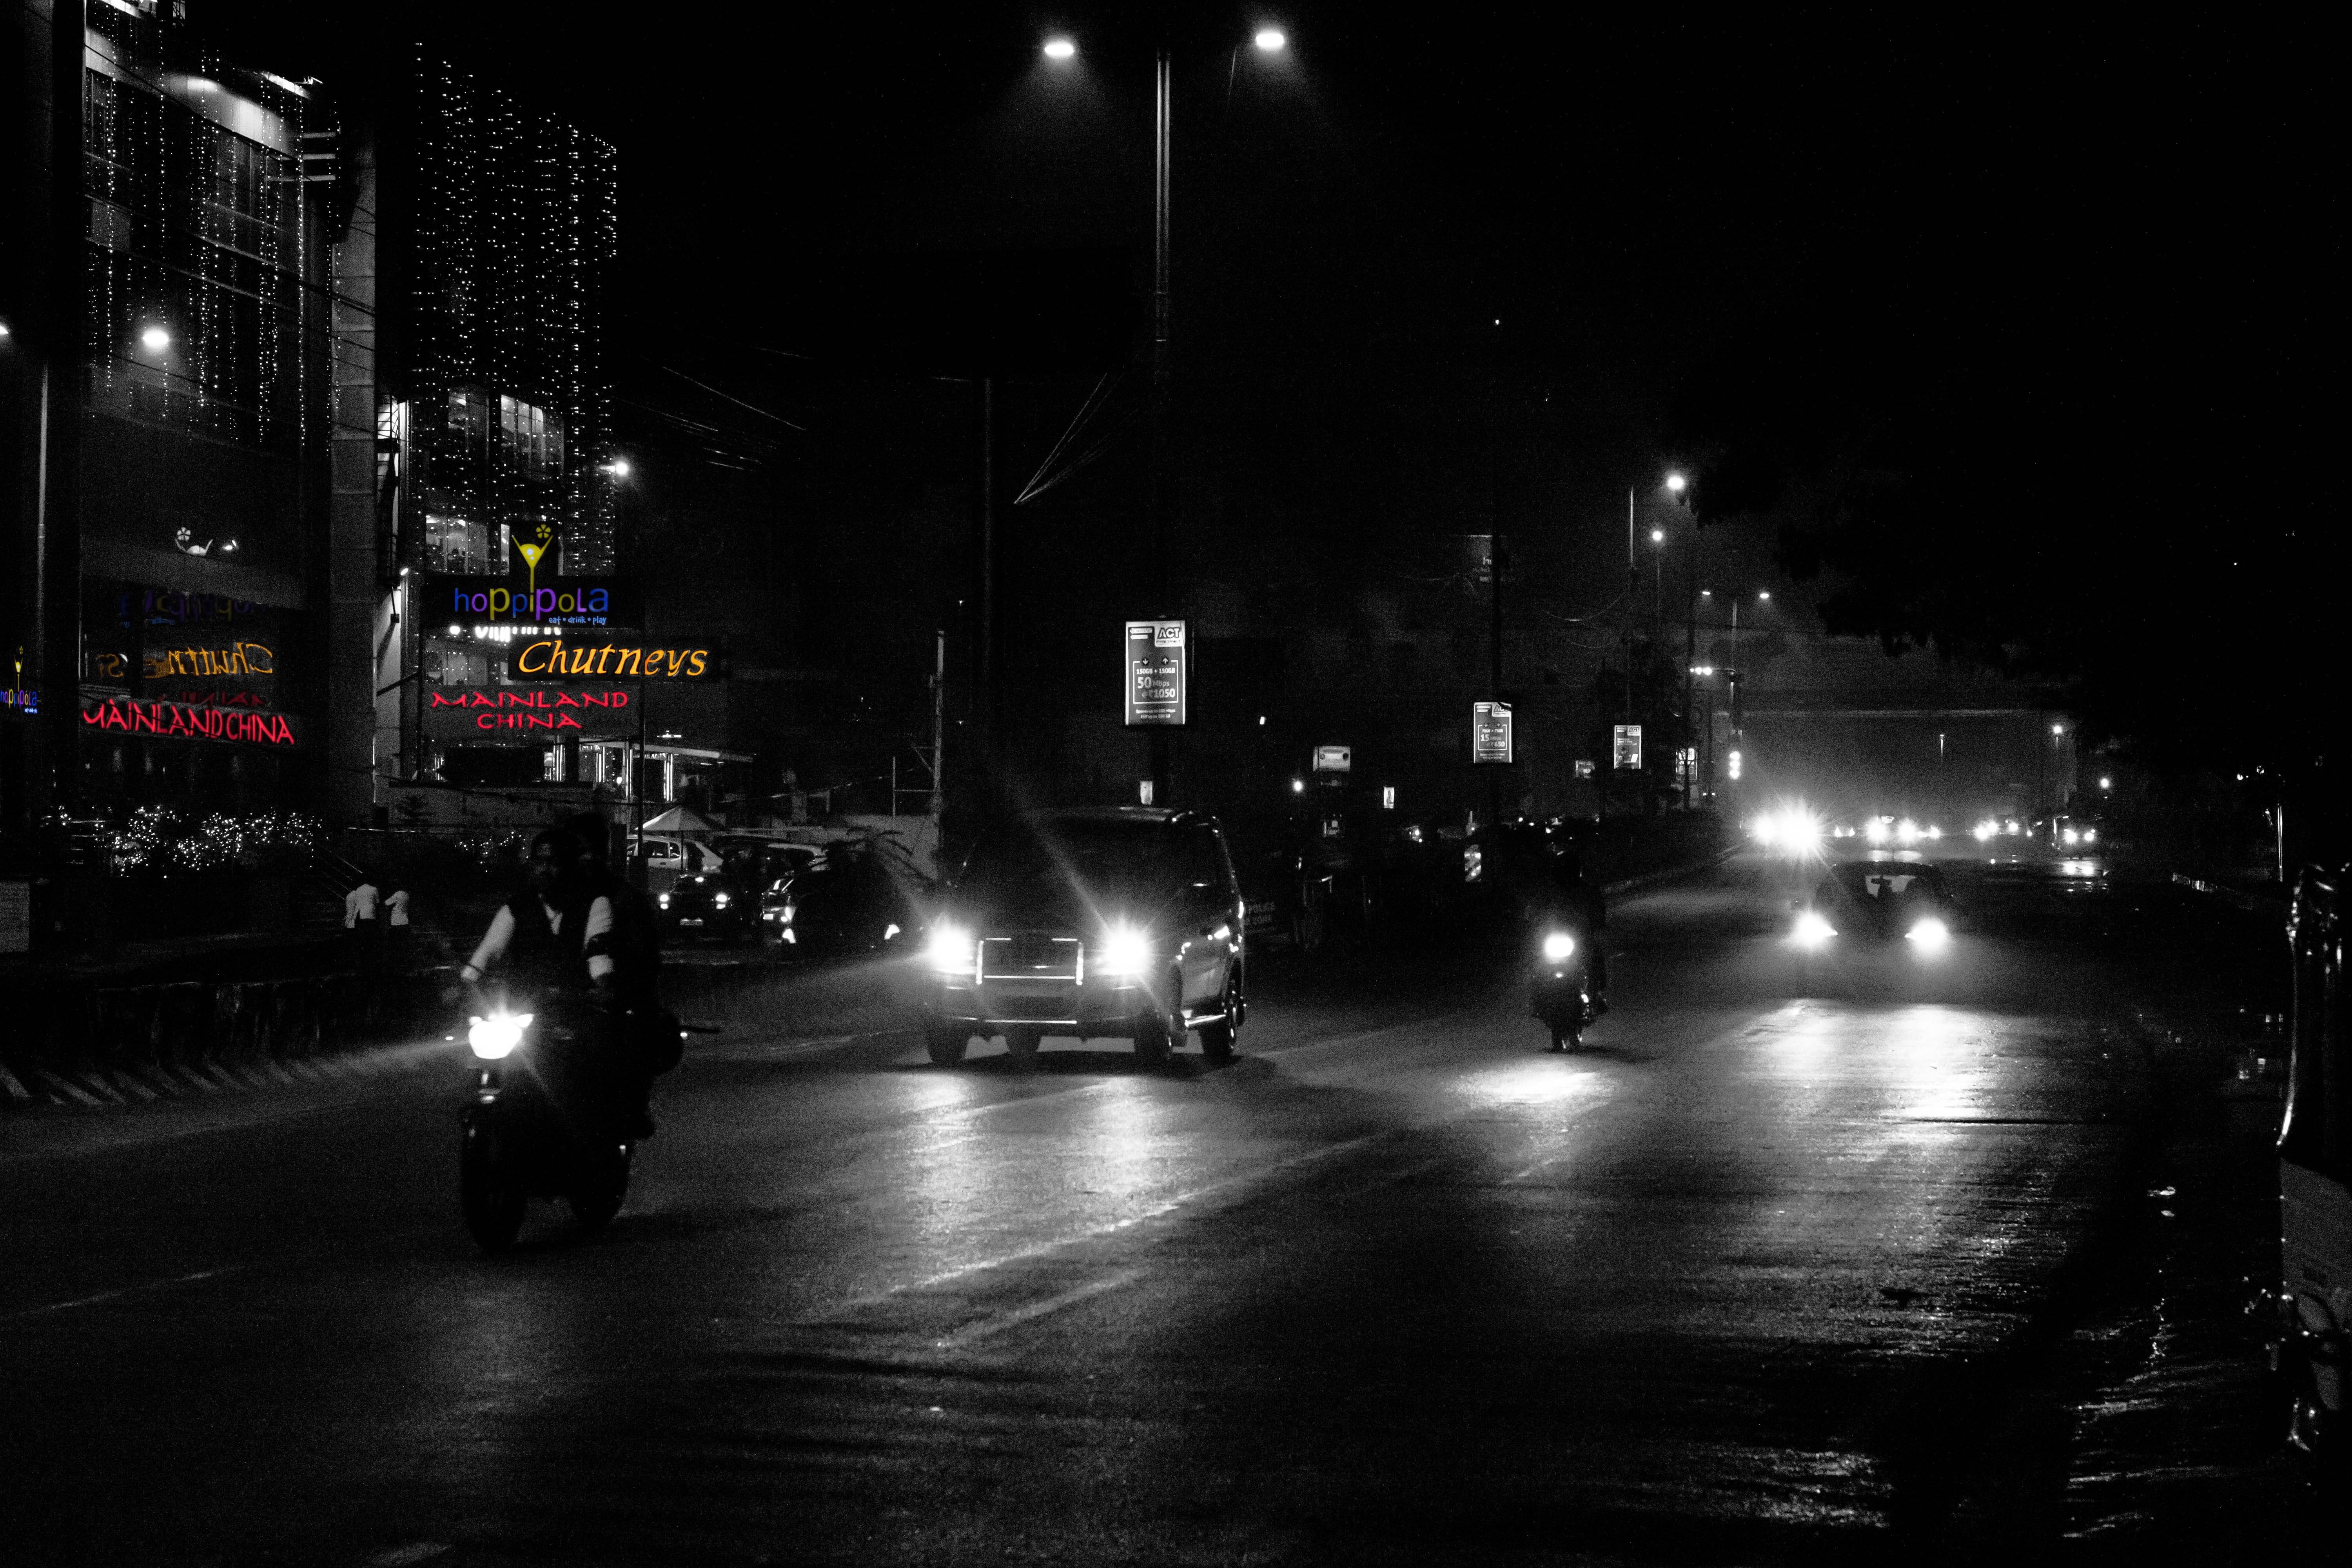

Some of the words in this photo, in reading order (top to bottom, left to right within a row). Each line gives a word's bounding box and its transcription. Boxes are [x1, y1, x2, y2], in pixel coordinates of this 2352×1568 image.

[549, 616, 561, 625] eat
[593, 615, 607, 625] play
[1158, 628, 1180, 639] ACT
[518, 640, 708, 677] Chutneys
[1138, 677, 1152, 688] 50
[432, 691, 628, 708] MAINLAND
[83, 699, 223, 739] MAINLAND
[226, 713, 295, 744] CHINA
[477, 712, 583, 729] CHINA
